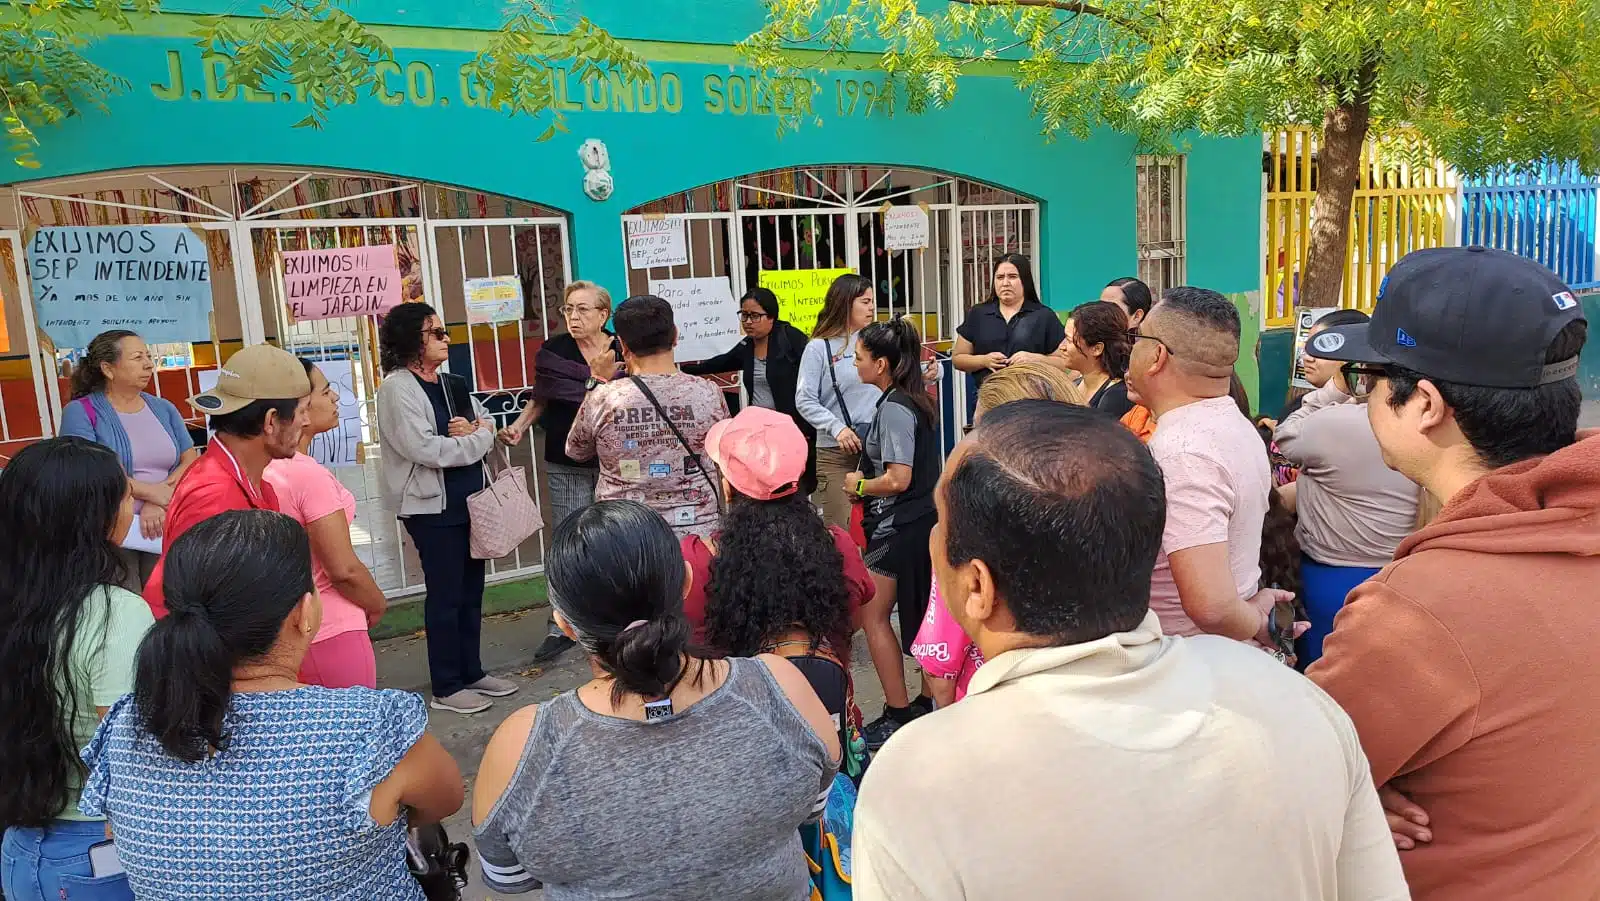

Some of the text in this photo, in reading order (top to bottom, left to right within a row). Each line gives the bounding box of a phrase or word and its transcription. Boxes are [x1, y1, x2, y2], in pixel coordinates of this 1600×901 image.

[459, 60, 684, 114] GILONDO
[703, 73, 814, 117] SOLER
[834, 78, 896, 120] 1994
[33, 230, 190, 255] EXIJIMOS A
[660, 235, 672, 245] DE
[631, 249, 648, 259] SEP
[32, 257, 208, 281] SEP INTENDENTE
[290, 275, 388, 298] LIMPIEZA EN
[657, 283, 703, 299] Paro de
[105, 294, 119, 302] DE
[175, 294, 191, 302] SIN
[292, 295, 384, 318] EL JARDIN
[793, 293, 826, 308] INTEND
[45, 319, 91, 327] INTENDENTE
[613, 404, 695, 425] PRENSA
[910, 641, 951, 662] Barbie
